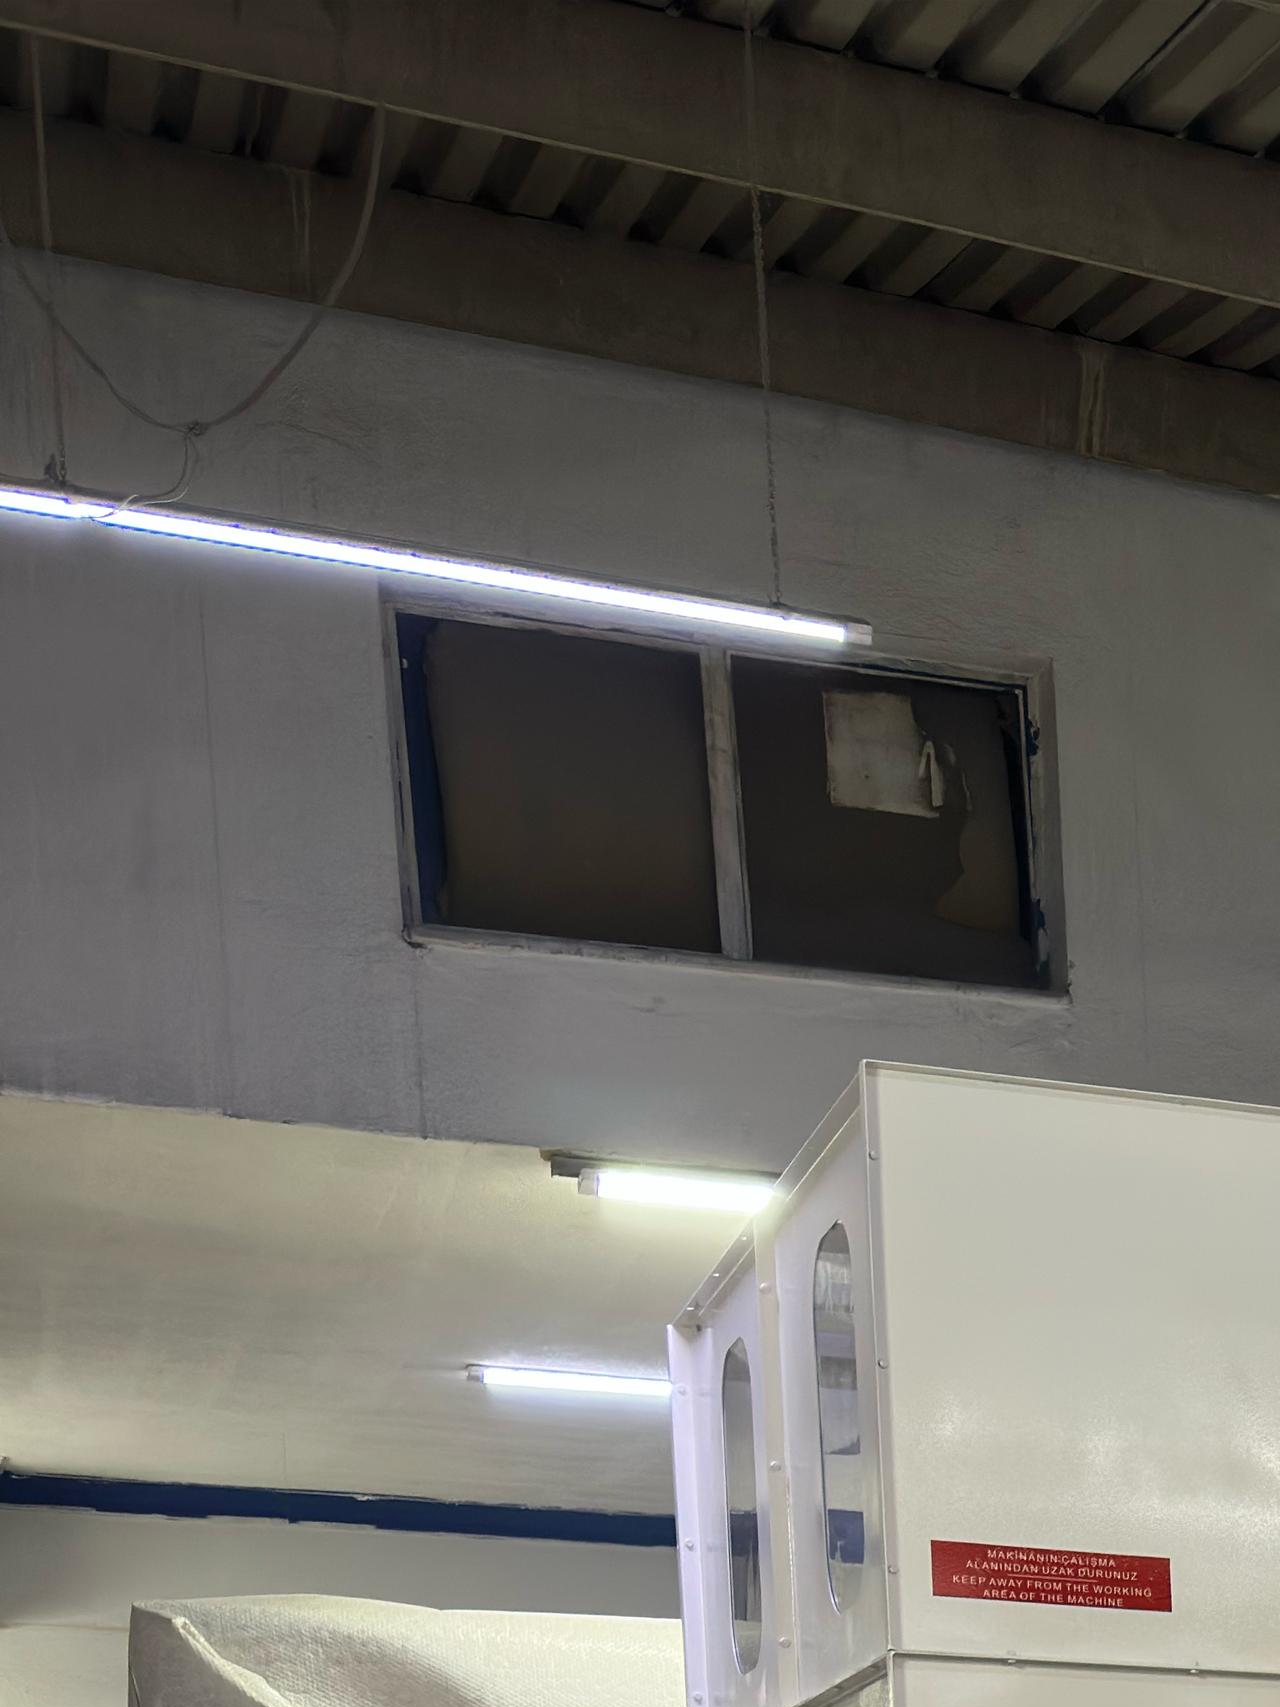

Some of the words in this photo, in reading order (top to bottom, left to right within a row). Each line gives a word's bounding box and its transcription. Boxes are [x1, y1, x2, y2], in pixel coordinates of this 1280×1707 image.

[1061, 1555, 1116, 1568] ÇALIŞMA
[966, 1560, 1038, 1573] ALANINDAN
[1042, 1566, 1074, 1576] UZAK
[1078, 1568, 1138, 1581] DURUNUZ
[952, 1575, 986, 1585] KEEP
[989, 1578, 1022, 1587] AWAY
[1027, 1580, 1062, 1590] FROM
[1066, 1583, 1089, 1593] THE
[983, 1589, 1016, 1599] AREA
[1020, 1592, 1036, 1601] OF
[1040, 1593, 1063, 1603] THE
